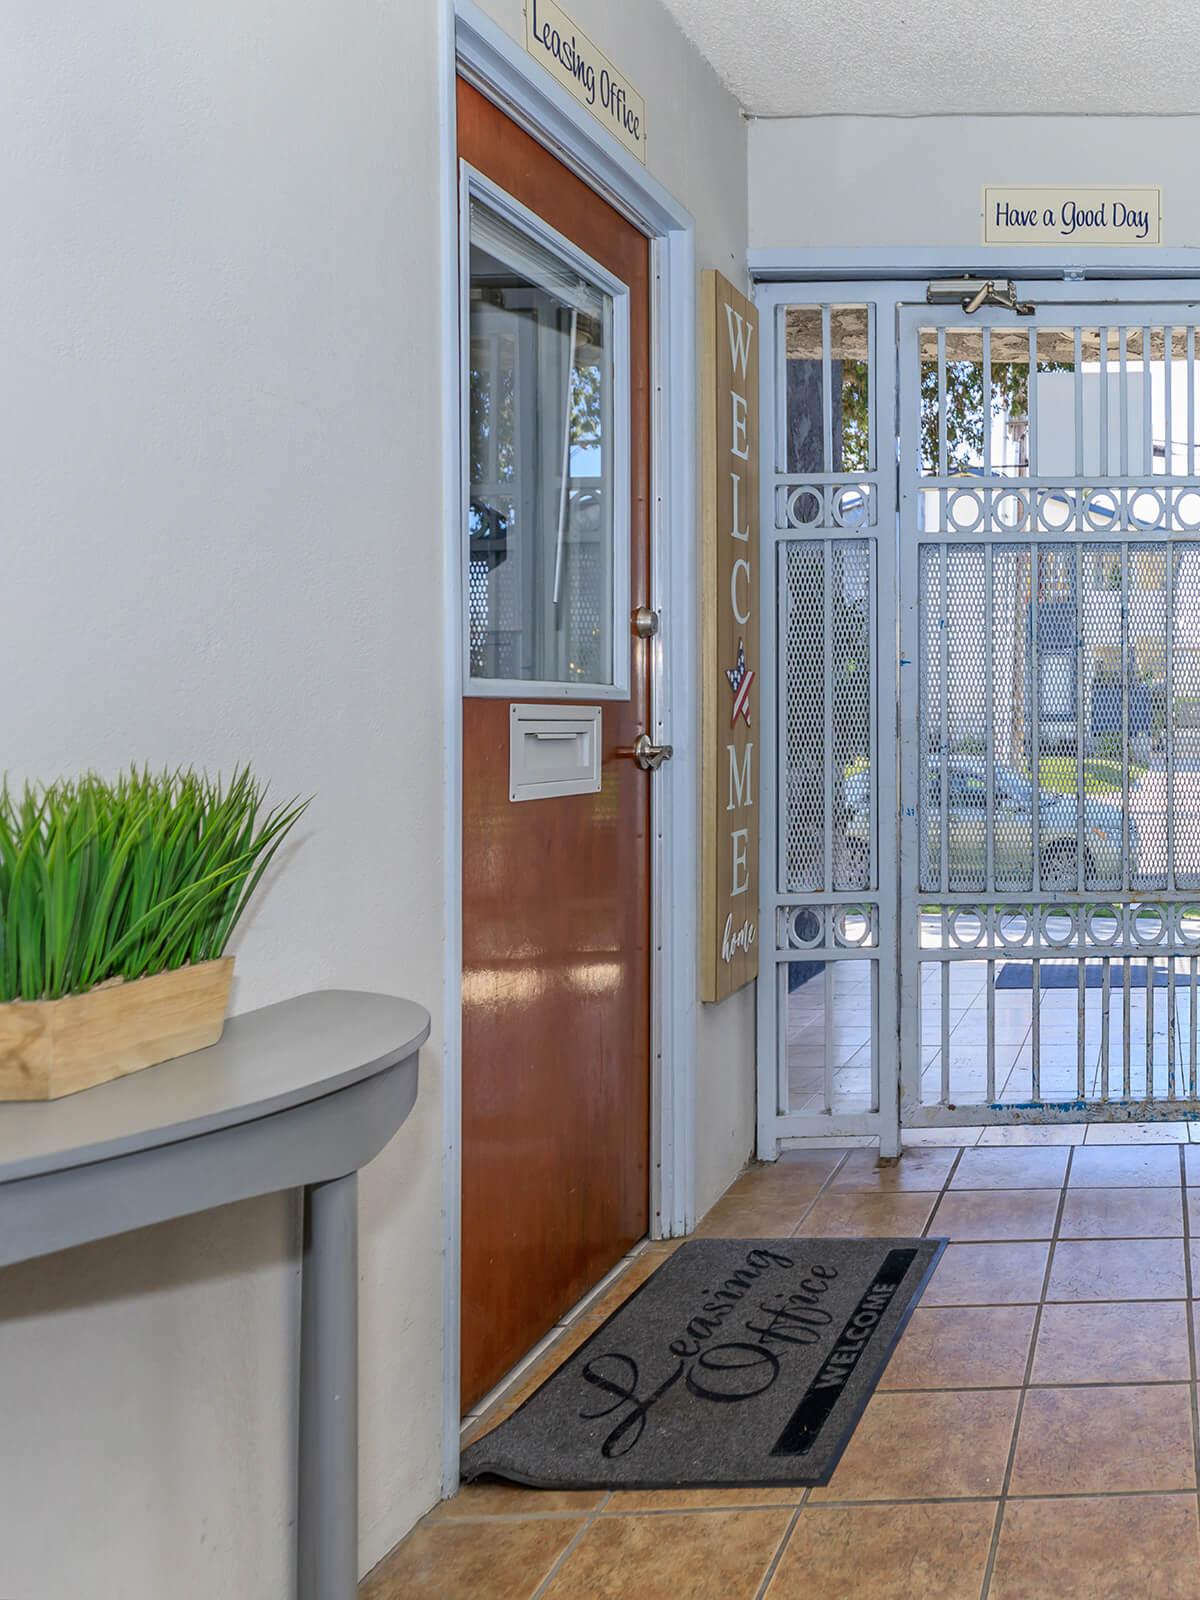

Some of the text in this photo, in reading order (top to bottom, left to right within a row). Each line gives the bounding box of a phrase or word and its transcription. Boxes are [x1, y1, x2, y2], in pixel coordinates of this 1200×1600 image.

[532, 0, 640, 140] Leasing Office
[996, 201, 1149, 238] Have a Good Day
[725, 303, 754, 896] WELCME
[722, 912, 756, 963] home
[579, 1247, 795, 1459] Leasing
[685, 1264, 839, 1402] Office
[814, 1282, 897, 1389] WELCOME
